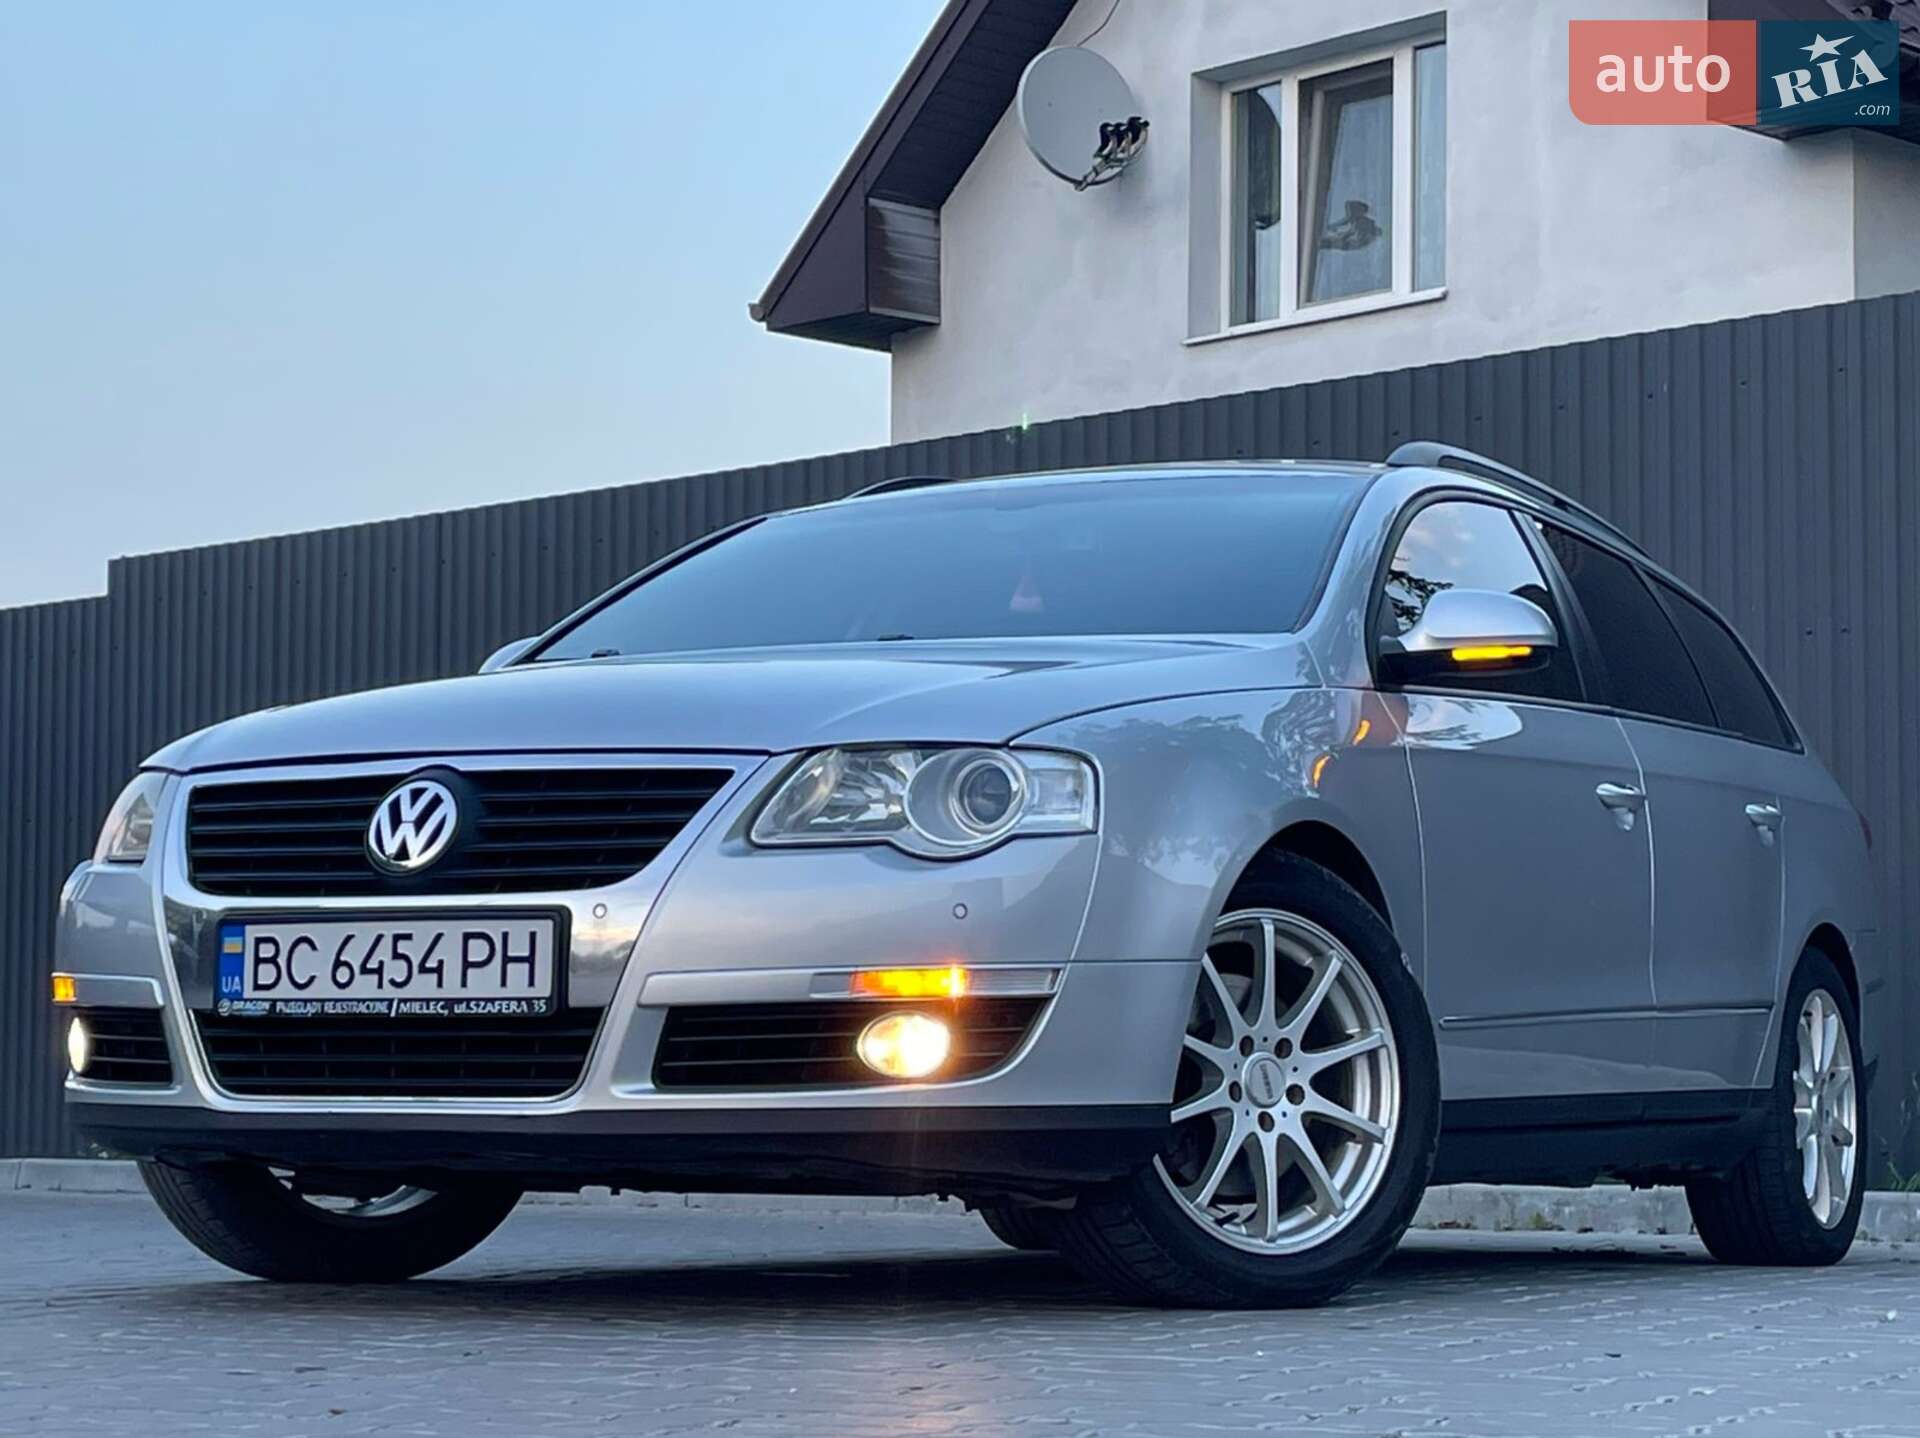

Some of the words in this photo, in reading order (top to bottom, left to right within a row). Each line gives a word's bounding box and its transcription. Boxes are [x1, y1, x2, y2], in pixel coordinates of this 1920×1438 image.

[252, 934, 319, 991] BC
[330, 931, 445, 990] 6454
[460, 930, 538, 989] PH
[222, 976, 242, 993] UA
